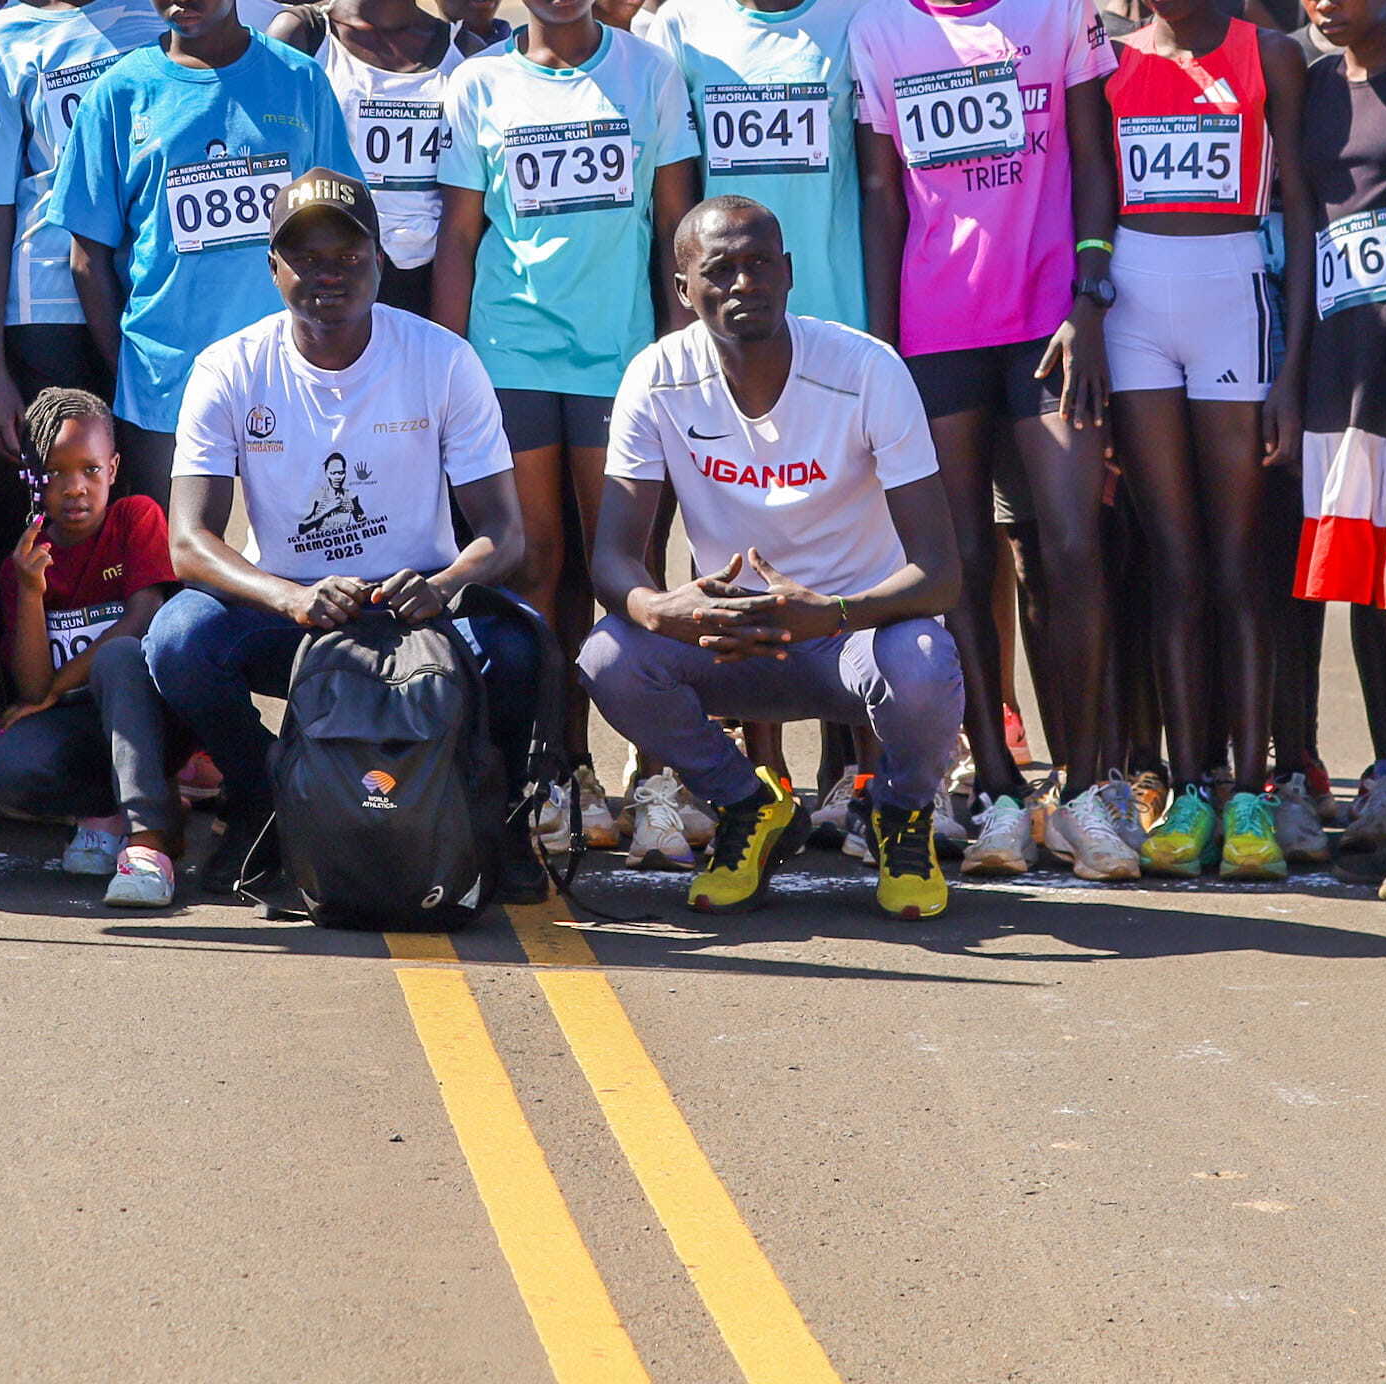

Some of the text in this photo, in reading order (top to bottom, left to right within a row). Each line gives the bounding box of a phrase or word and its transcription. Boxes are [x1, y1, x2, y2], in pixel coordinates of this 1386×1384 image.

[791, 86, 825, 94] mezzo
[895, 77, 974, 97] MEMORIAL RUN
[705, 91, 785, 103] MEMORIAL RUN
[1022, 88, 1048, 111] UF
[359, 108, 440, 119] MEMORIAL RUN
[905, 91, 1013, 143] 1003
[1203, 117, 1238, 127] mezzo
[518, 126, 551, 135] REBECCA
[594, 123, 628, 132] mezzo
[712, 107, 814, 149] 0641
[1120, 123, 1197, 134] MEMORIAL RUN
[505, 130, 589, 147] MEMORIAL RUN
[252, 157, 288, 169] mezzo
[515, 143, 625, 191] 0739
[1129, 141, 1231, 183] 0445
[166, 166, 249, 188] MEMORIAL RUN
[962, 160, 1024, 193] TRIER
[287, 178, 356, 209] PARIS
[175, 183, 281, 233] 0888
[1350, 219, 1373, 232] RUN
[689, 451, 828, 489] UGANDA
[294, 524, 387, 554] MEMORIAL RUN
[324, 543, 364, 562] 2025
[89, 605, 124, 618] mezzo
[61, 617, 85, 630] RUN
[368, 795, 389, 803] WORLD
